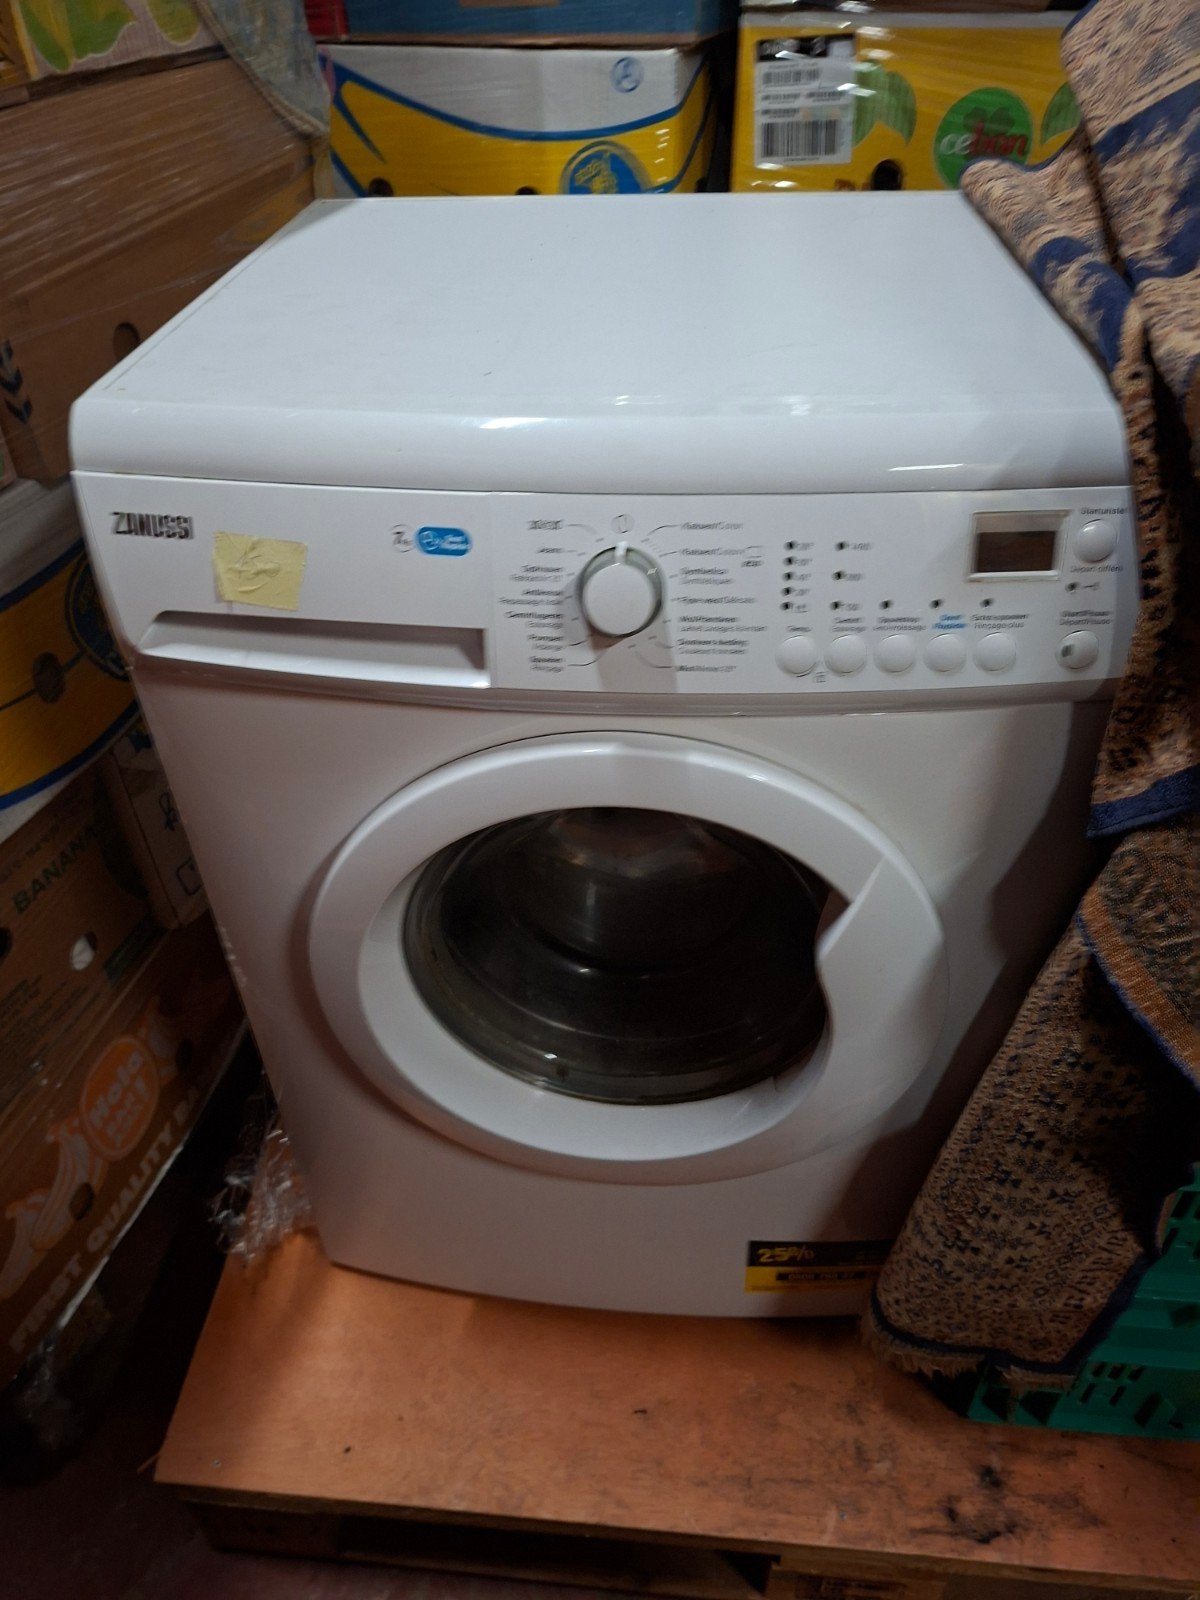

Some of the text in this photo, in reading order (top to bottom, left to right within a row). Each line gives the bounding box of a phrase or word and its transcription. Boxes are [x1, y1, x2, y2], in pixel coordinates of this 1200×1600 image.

[109, 512, 194, 540] ZANUSSI
[8, 1252, 83, 1354] FIRST
[86, 1124, 176, 1251] QUALITY
[756, 1244, 816, 1263] 25%
